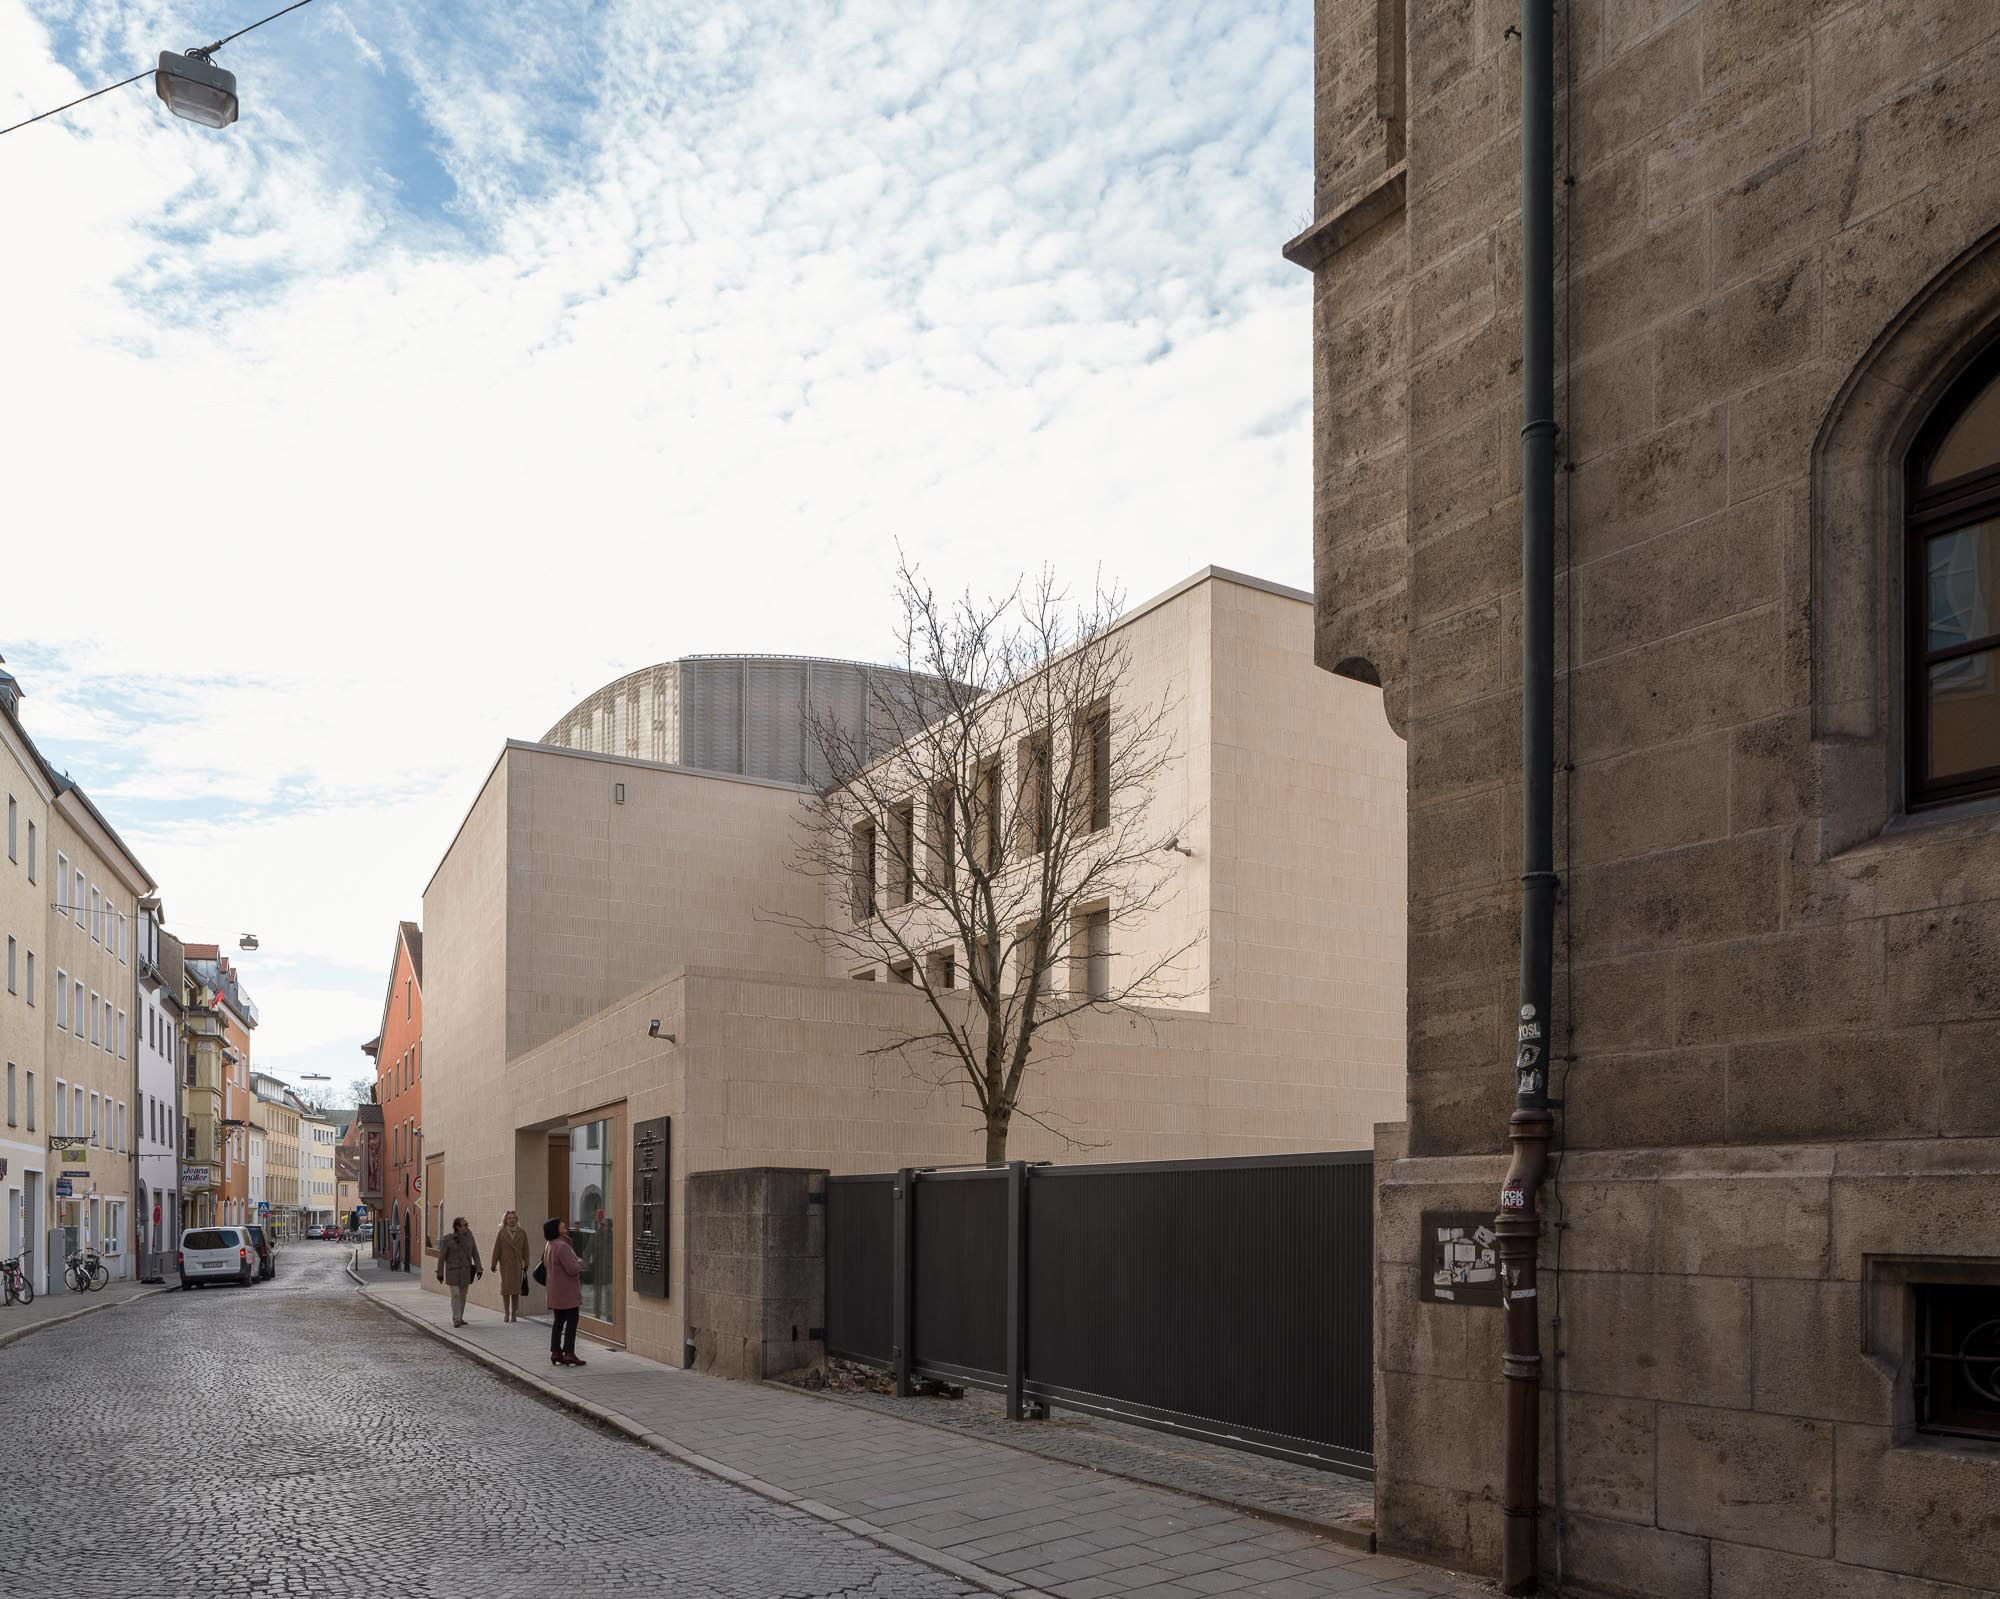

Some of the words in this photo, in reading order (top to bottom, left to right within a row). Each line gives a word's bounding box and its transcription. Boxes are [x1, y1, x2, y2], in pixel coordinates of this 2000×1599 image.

[183, 1167, 209, 1175] Jeans
[182, 1173, 208, 1181] müller
[1505, 1190, 1523, 1199] FCK
[1505, 1198, 1524, 1207] AFD
